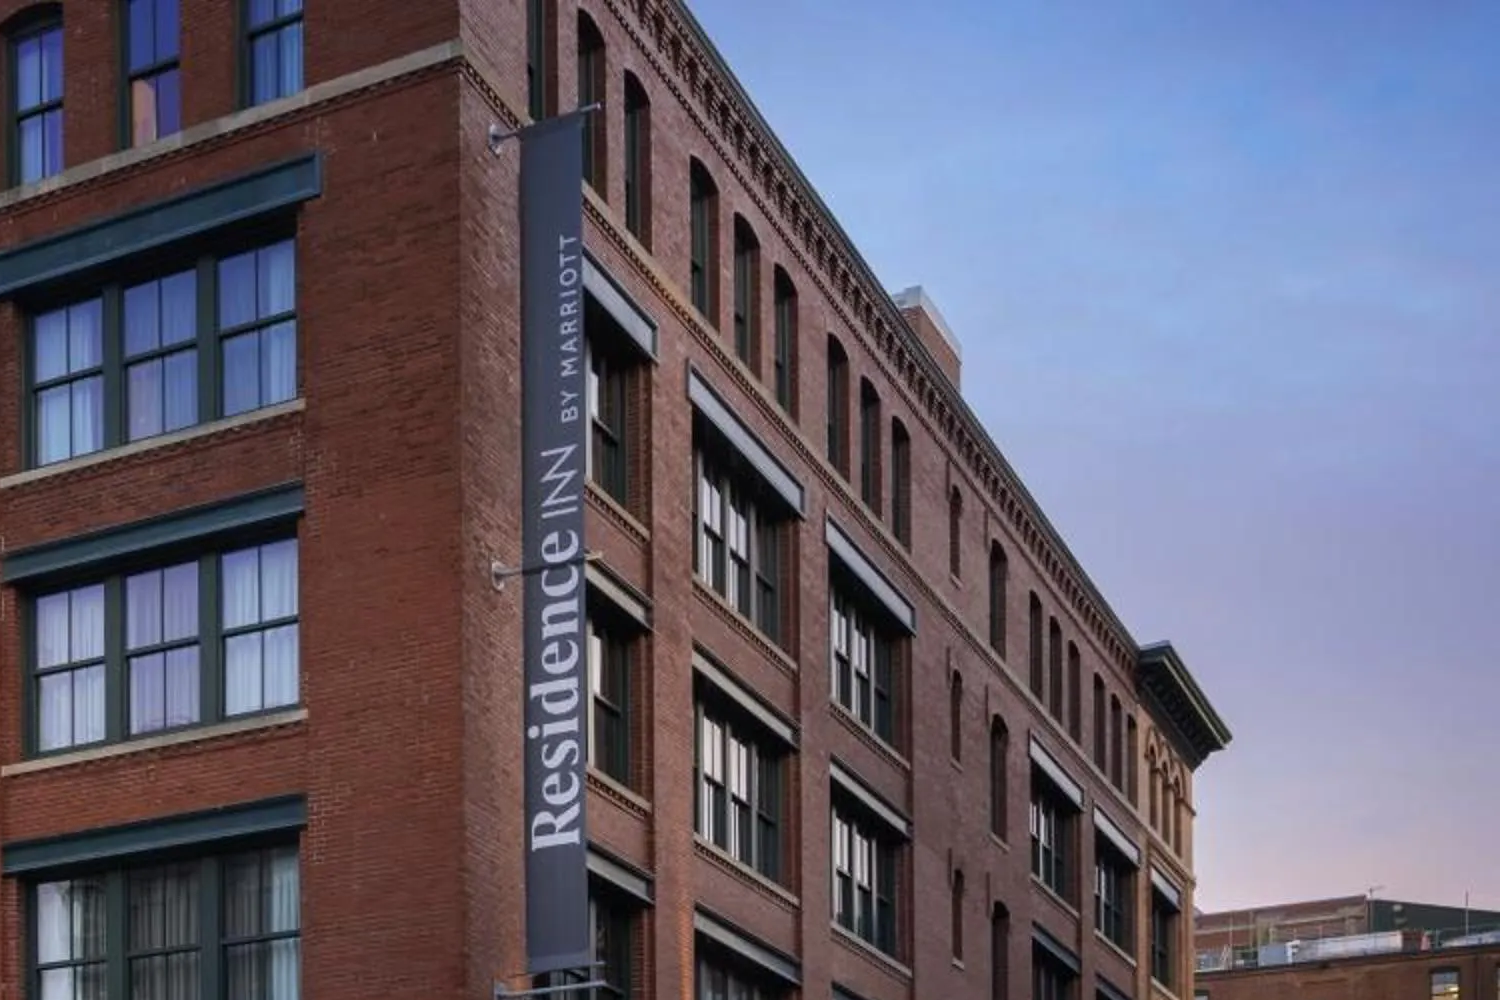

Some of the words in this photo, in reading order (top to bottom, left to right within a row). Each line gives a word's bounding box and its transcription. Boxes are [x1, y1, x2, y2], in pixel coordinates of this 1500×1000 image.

[559, 234, 579, 376] MARRIOTT
[560, 392, 579, 424] BY
[540, 443, 579, 519] INN
[528, 528, 581, 852] Residence
